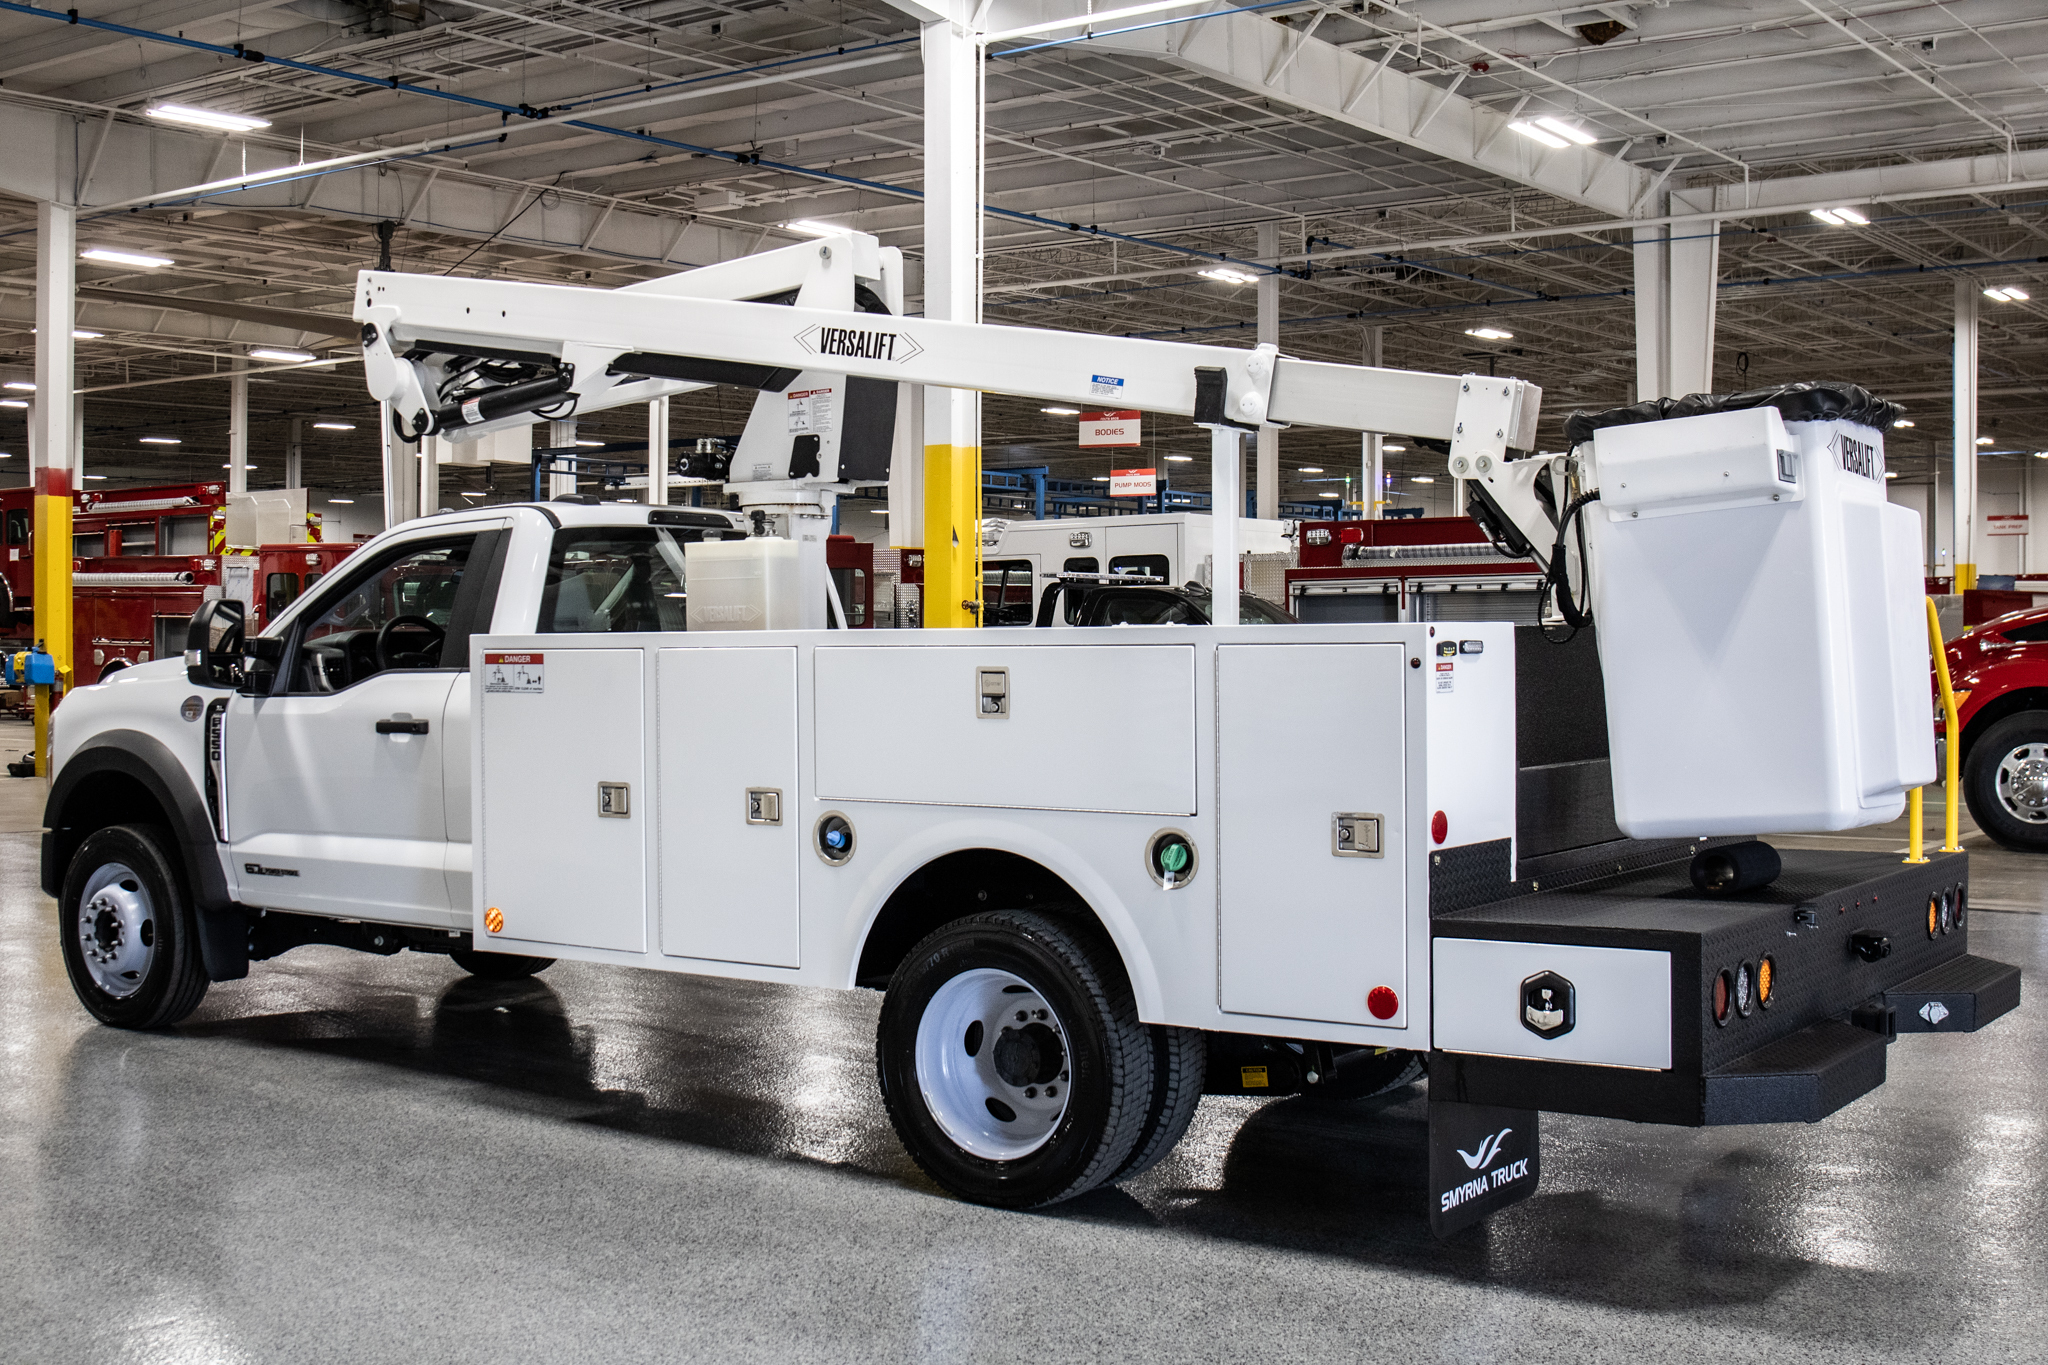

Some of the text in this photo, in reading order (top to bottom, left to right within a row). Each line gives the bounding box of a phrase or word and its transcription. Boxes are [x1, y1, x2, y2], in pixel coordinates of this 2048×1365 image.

[821, 327, 896, 361] VERSALIFT
[1096, 376, 1119, 385] NOTICE
[1095, 428, 1124, 436] BODIES
[1840, 434, 1875, 480] VERSALIFT
[703, 605, 747, 622] VERSALIFT
[504, 655, 531, 663] DANGER
[1441, 1158, 1529, 1212] SMYRNA TRUCK
